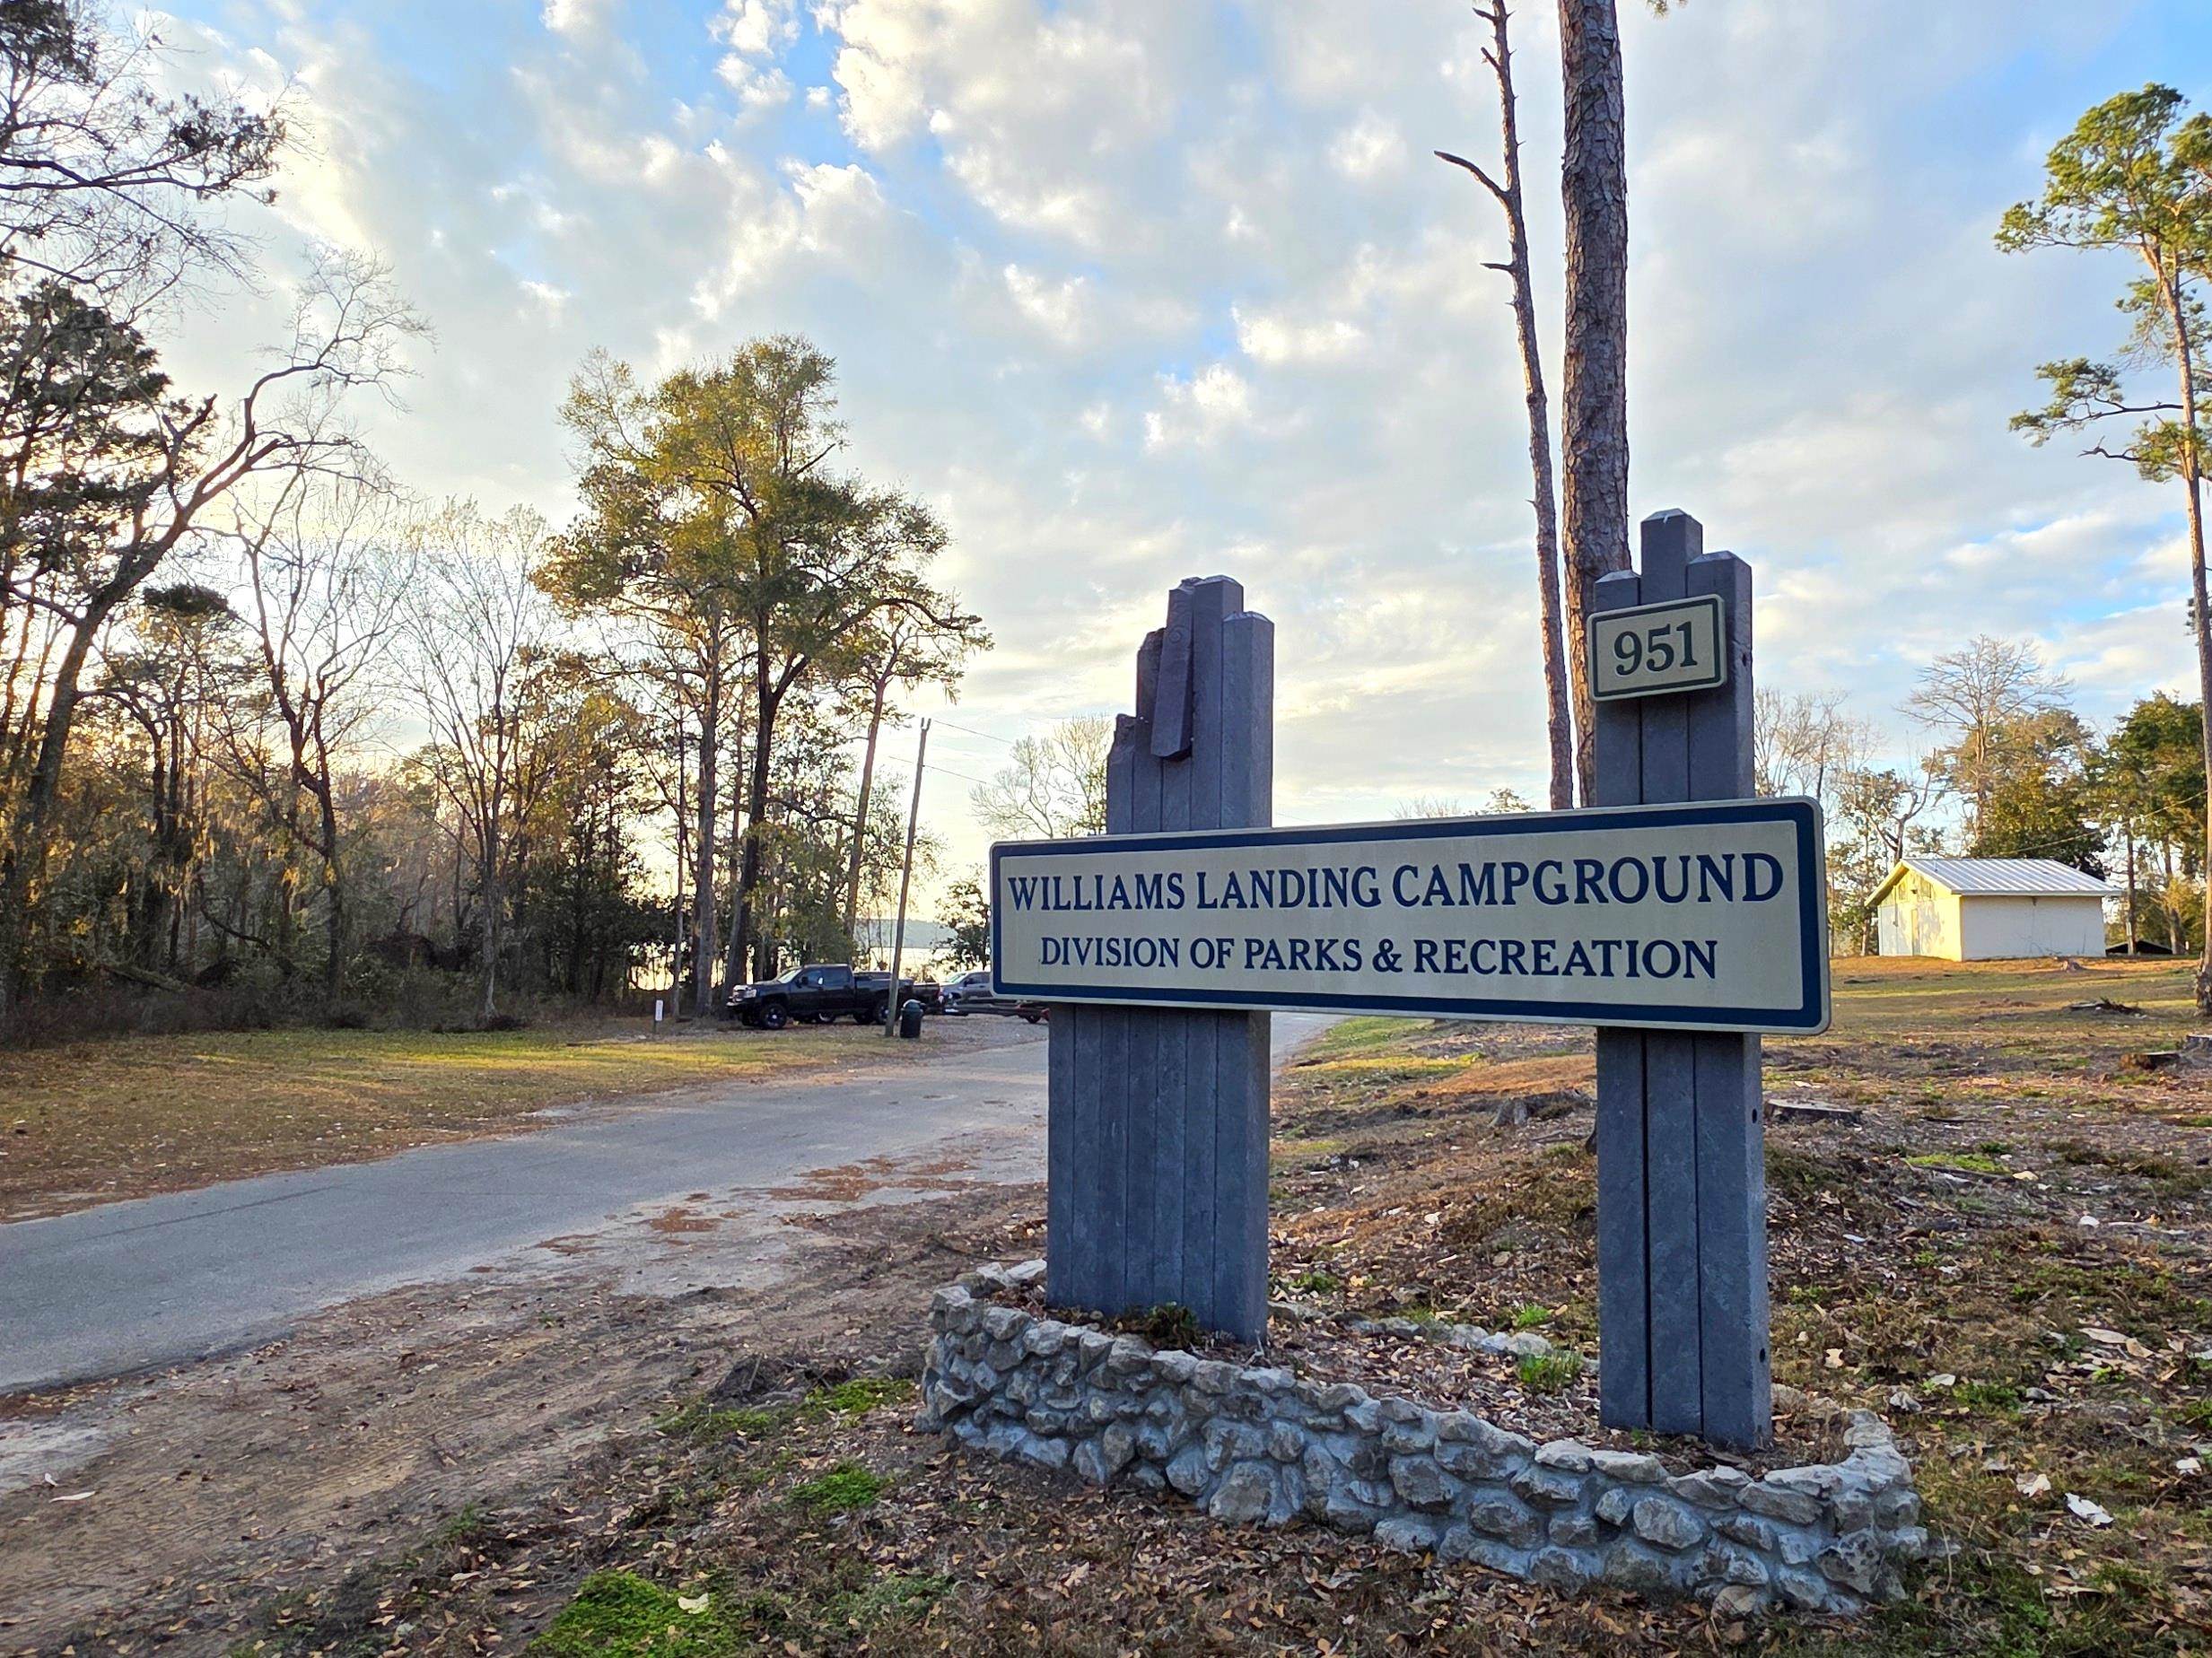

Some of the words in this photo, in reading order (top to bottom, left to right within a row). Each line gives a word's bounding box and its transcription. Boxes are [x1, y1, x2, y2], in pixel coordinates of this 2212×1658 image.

[1613, 621, 1698, 676] 951
[1008, 872, 1185, 911] WILLIAMS
[1196, 867, 1381, 909] LANDING
[1392, 852, 1784, 907] CAMPGROUND
[1041, 937, 1180, 968] DIVISION
[1190, 938, 1235, 969] OF
[1245, 938, 1362, 972] PARKS
[1372, 938, 1403, 973] &
[1413, 939, 1718, 979] RECREATION
